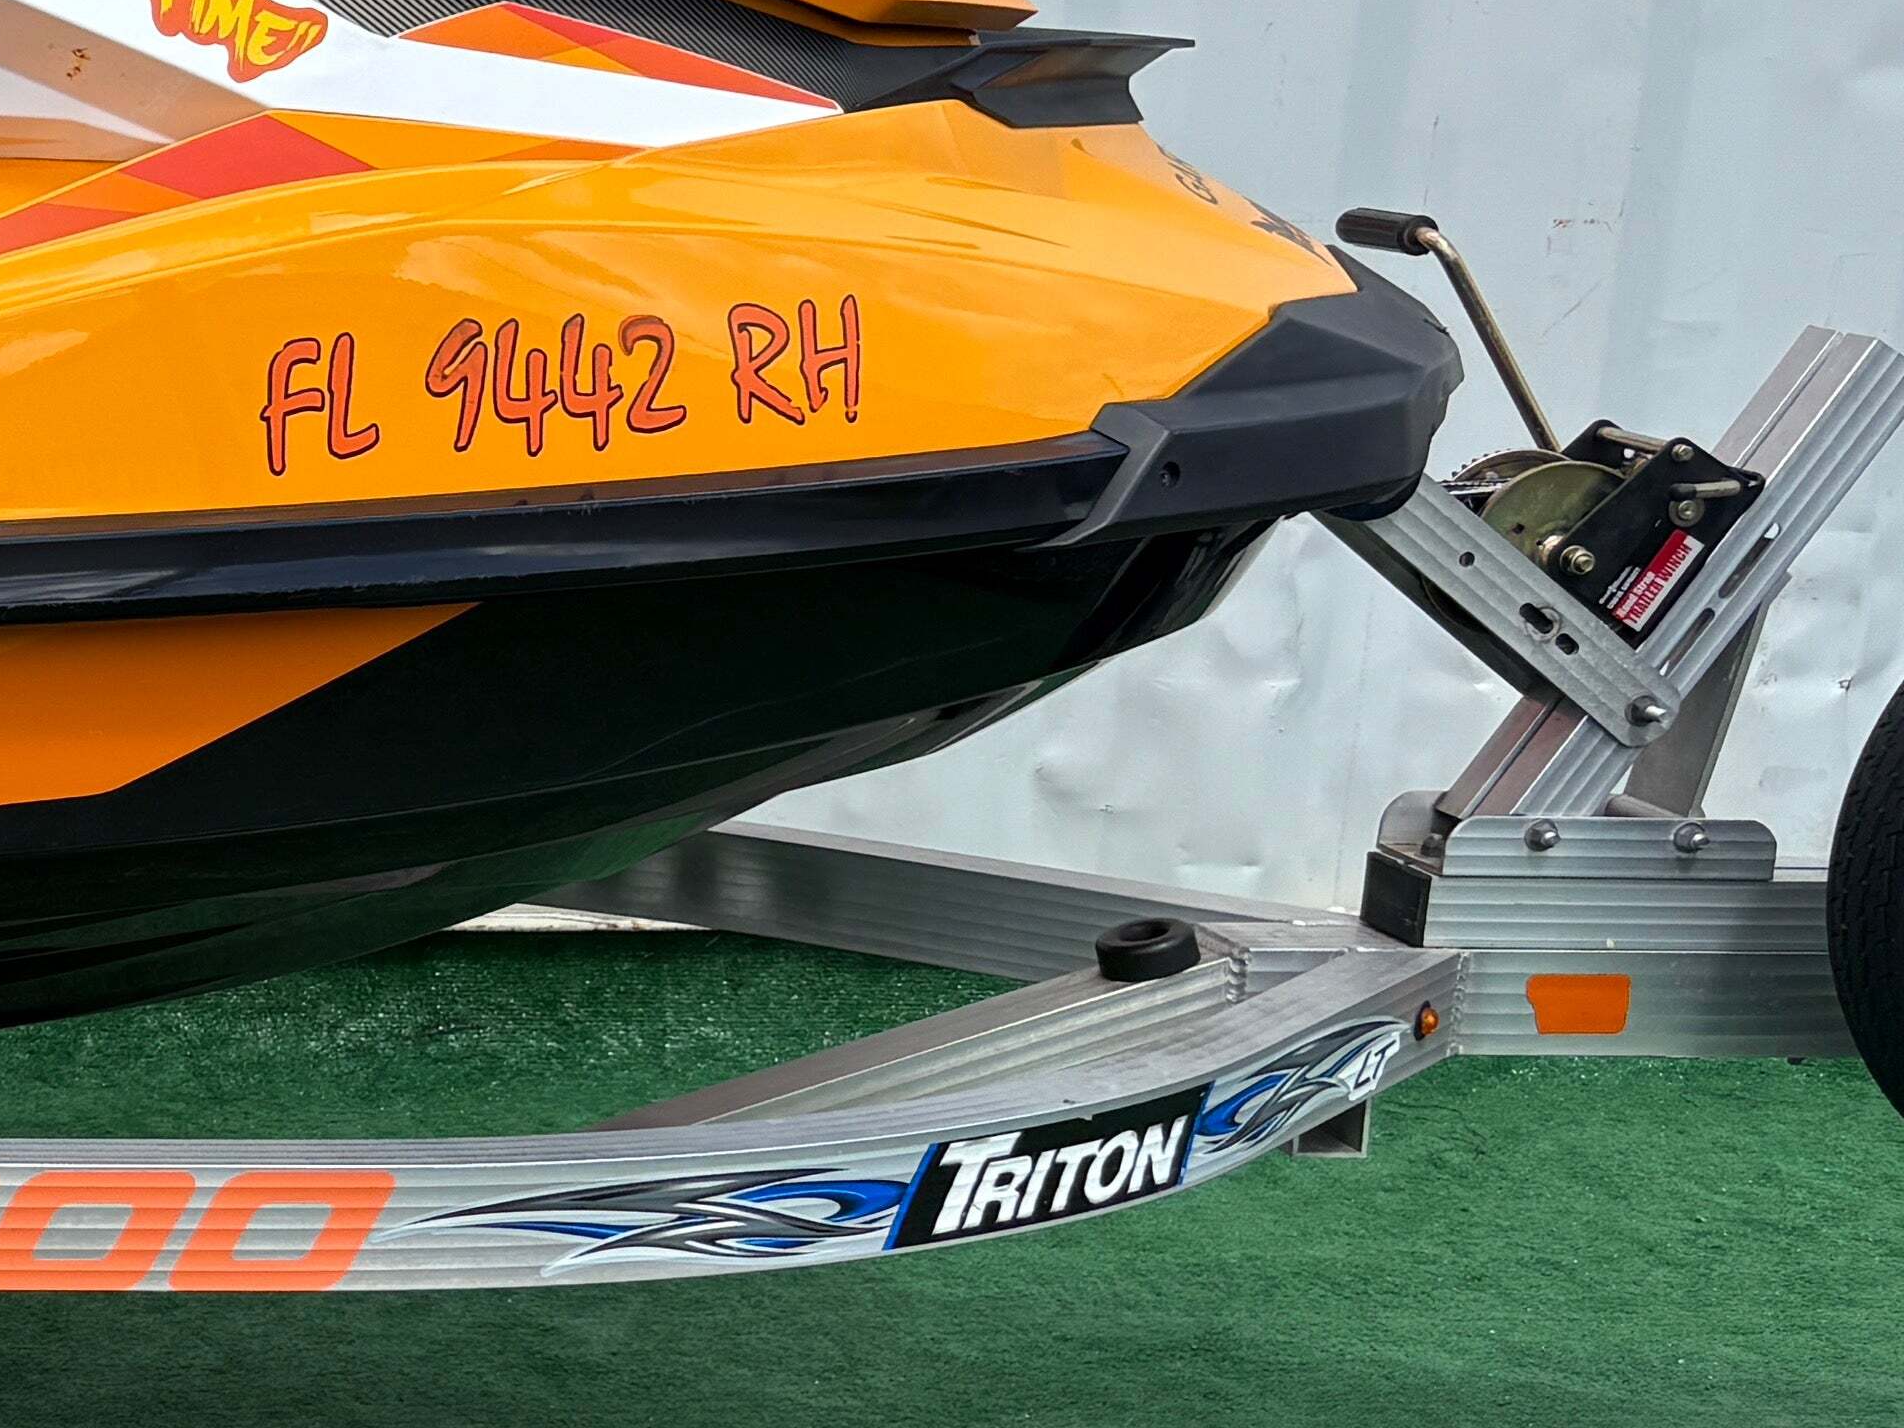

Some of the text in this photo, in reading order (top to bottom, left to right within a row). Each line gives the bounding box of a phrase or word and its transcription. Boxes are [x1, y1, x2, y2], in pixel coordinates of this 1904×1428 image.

[259, 293, 863, 476] FL 9442 RH
[1352, 1038, 1397, 1090] LT
[930, 1113, 1189, 1237] TRITON
